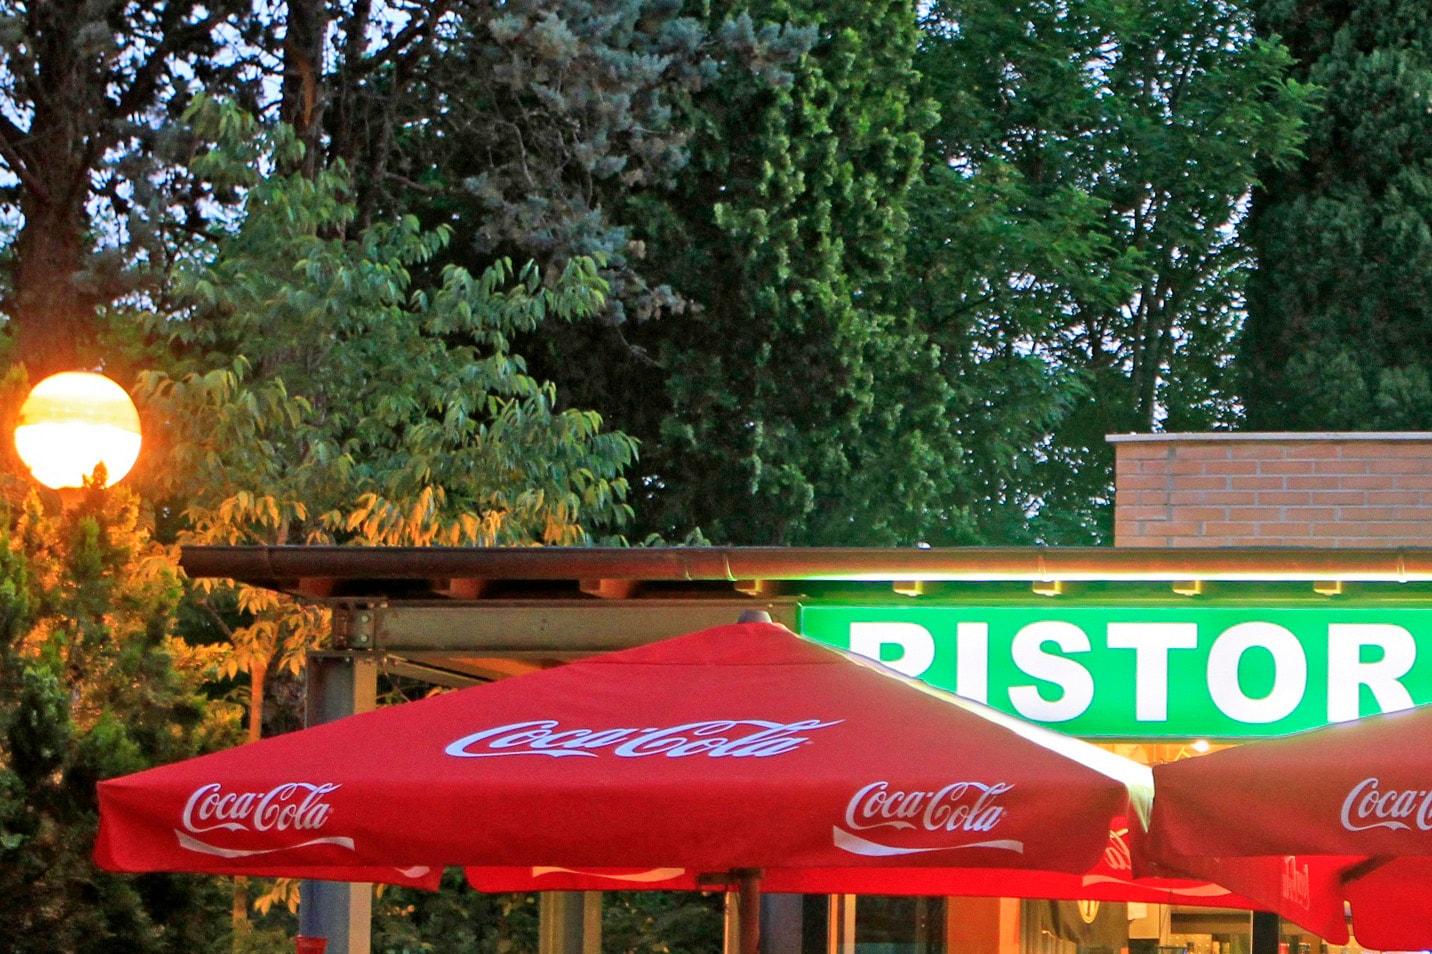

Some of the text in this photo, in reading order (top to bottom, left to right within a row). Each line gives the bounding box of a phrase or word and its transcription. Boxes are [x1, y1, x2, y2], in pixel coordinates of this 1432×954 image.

[444, 718, 846, 759] Coca-Cola
[183, 782, 342, 833] Coca-Cola
[845, 781, 1016, 832] Coca-Cola
